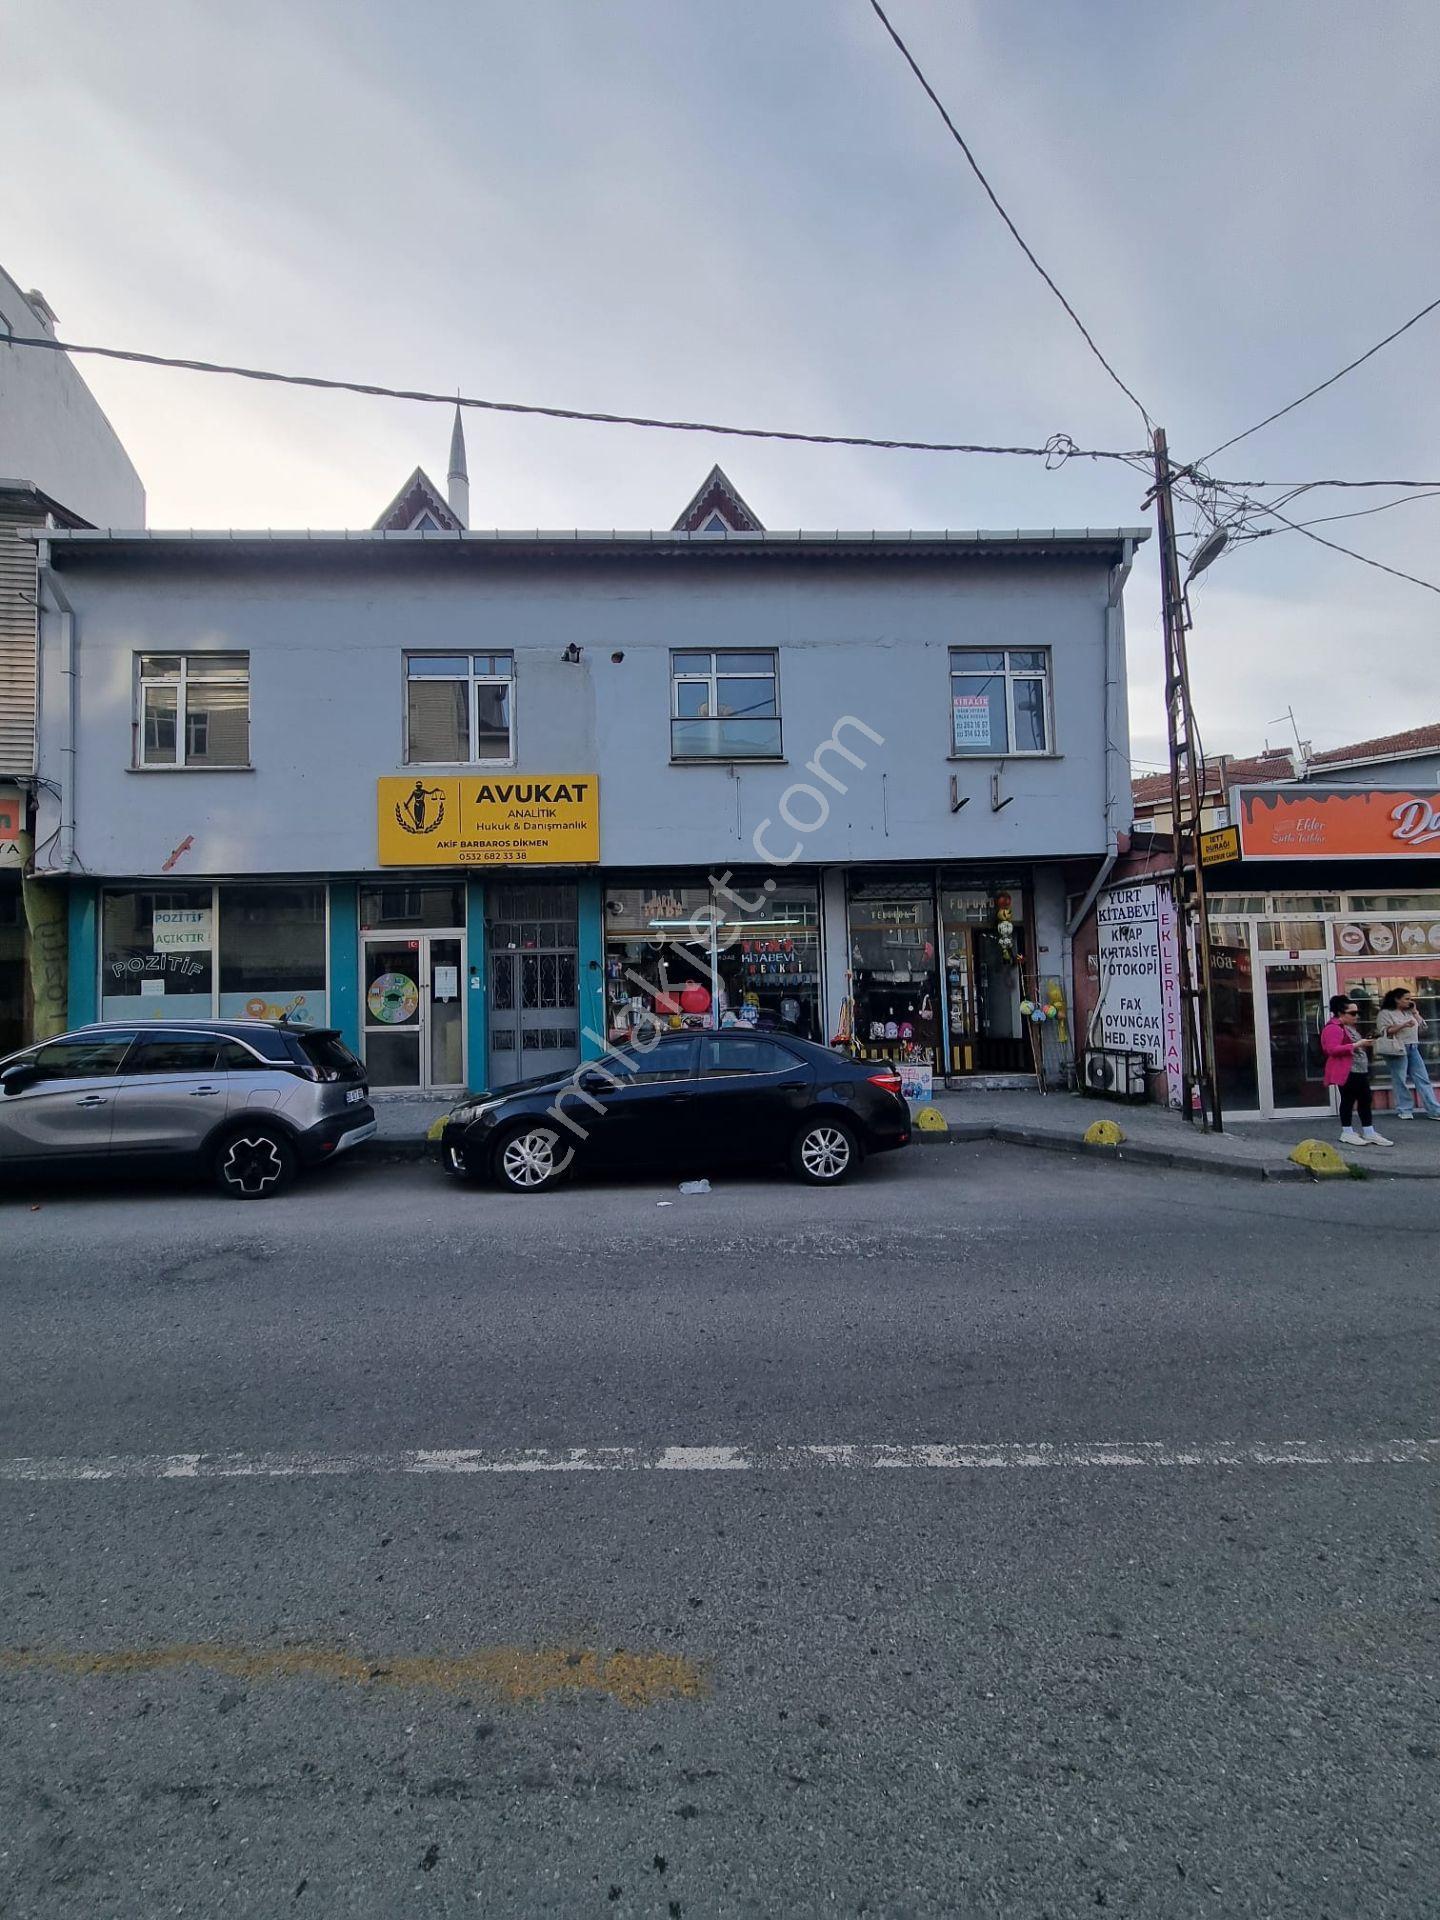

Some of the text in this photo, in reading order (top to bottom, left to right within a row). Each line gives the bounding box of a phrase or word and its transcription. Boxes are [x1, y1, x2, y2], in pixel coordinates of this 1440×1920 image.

[475, 784, 588, 804] AVUKAT
[476, 821, 588, 832] Hukuk & Danışmanlık
[436, 838, 549, 849] AKİF BARBAROS DİKMEN
[459, 852, 527, 861] 0532 682 33 38
[1109, 889, 1142, 905] YURT
[154, 911, 205, 923] POZİTİF
[1098, 900, 1157, 922] KİTABEVİ
[741, 951, 795, 963] KİTABEVİ
[1100, 942, 1158, 960] KIRTASİYE
[111, 952, 204, 978] POZİTİF
[1105, 1015, 1160, 1030] OYUNCAK
[1104, 1031, 1161, 1049] HED. EŞYA
